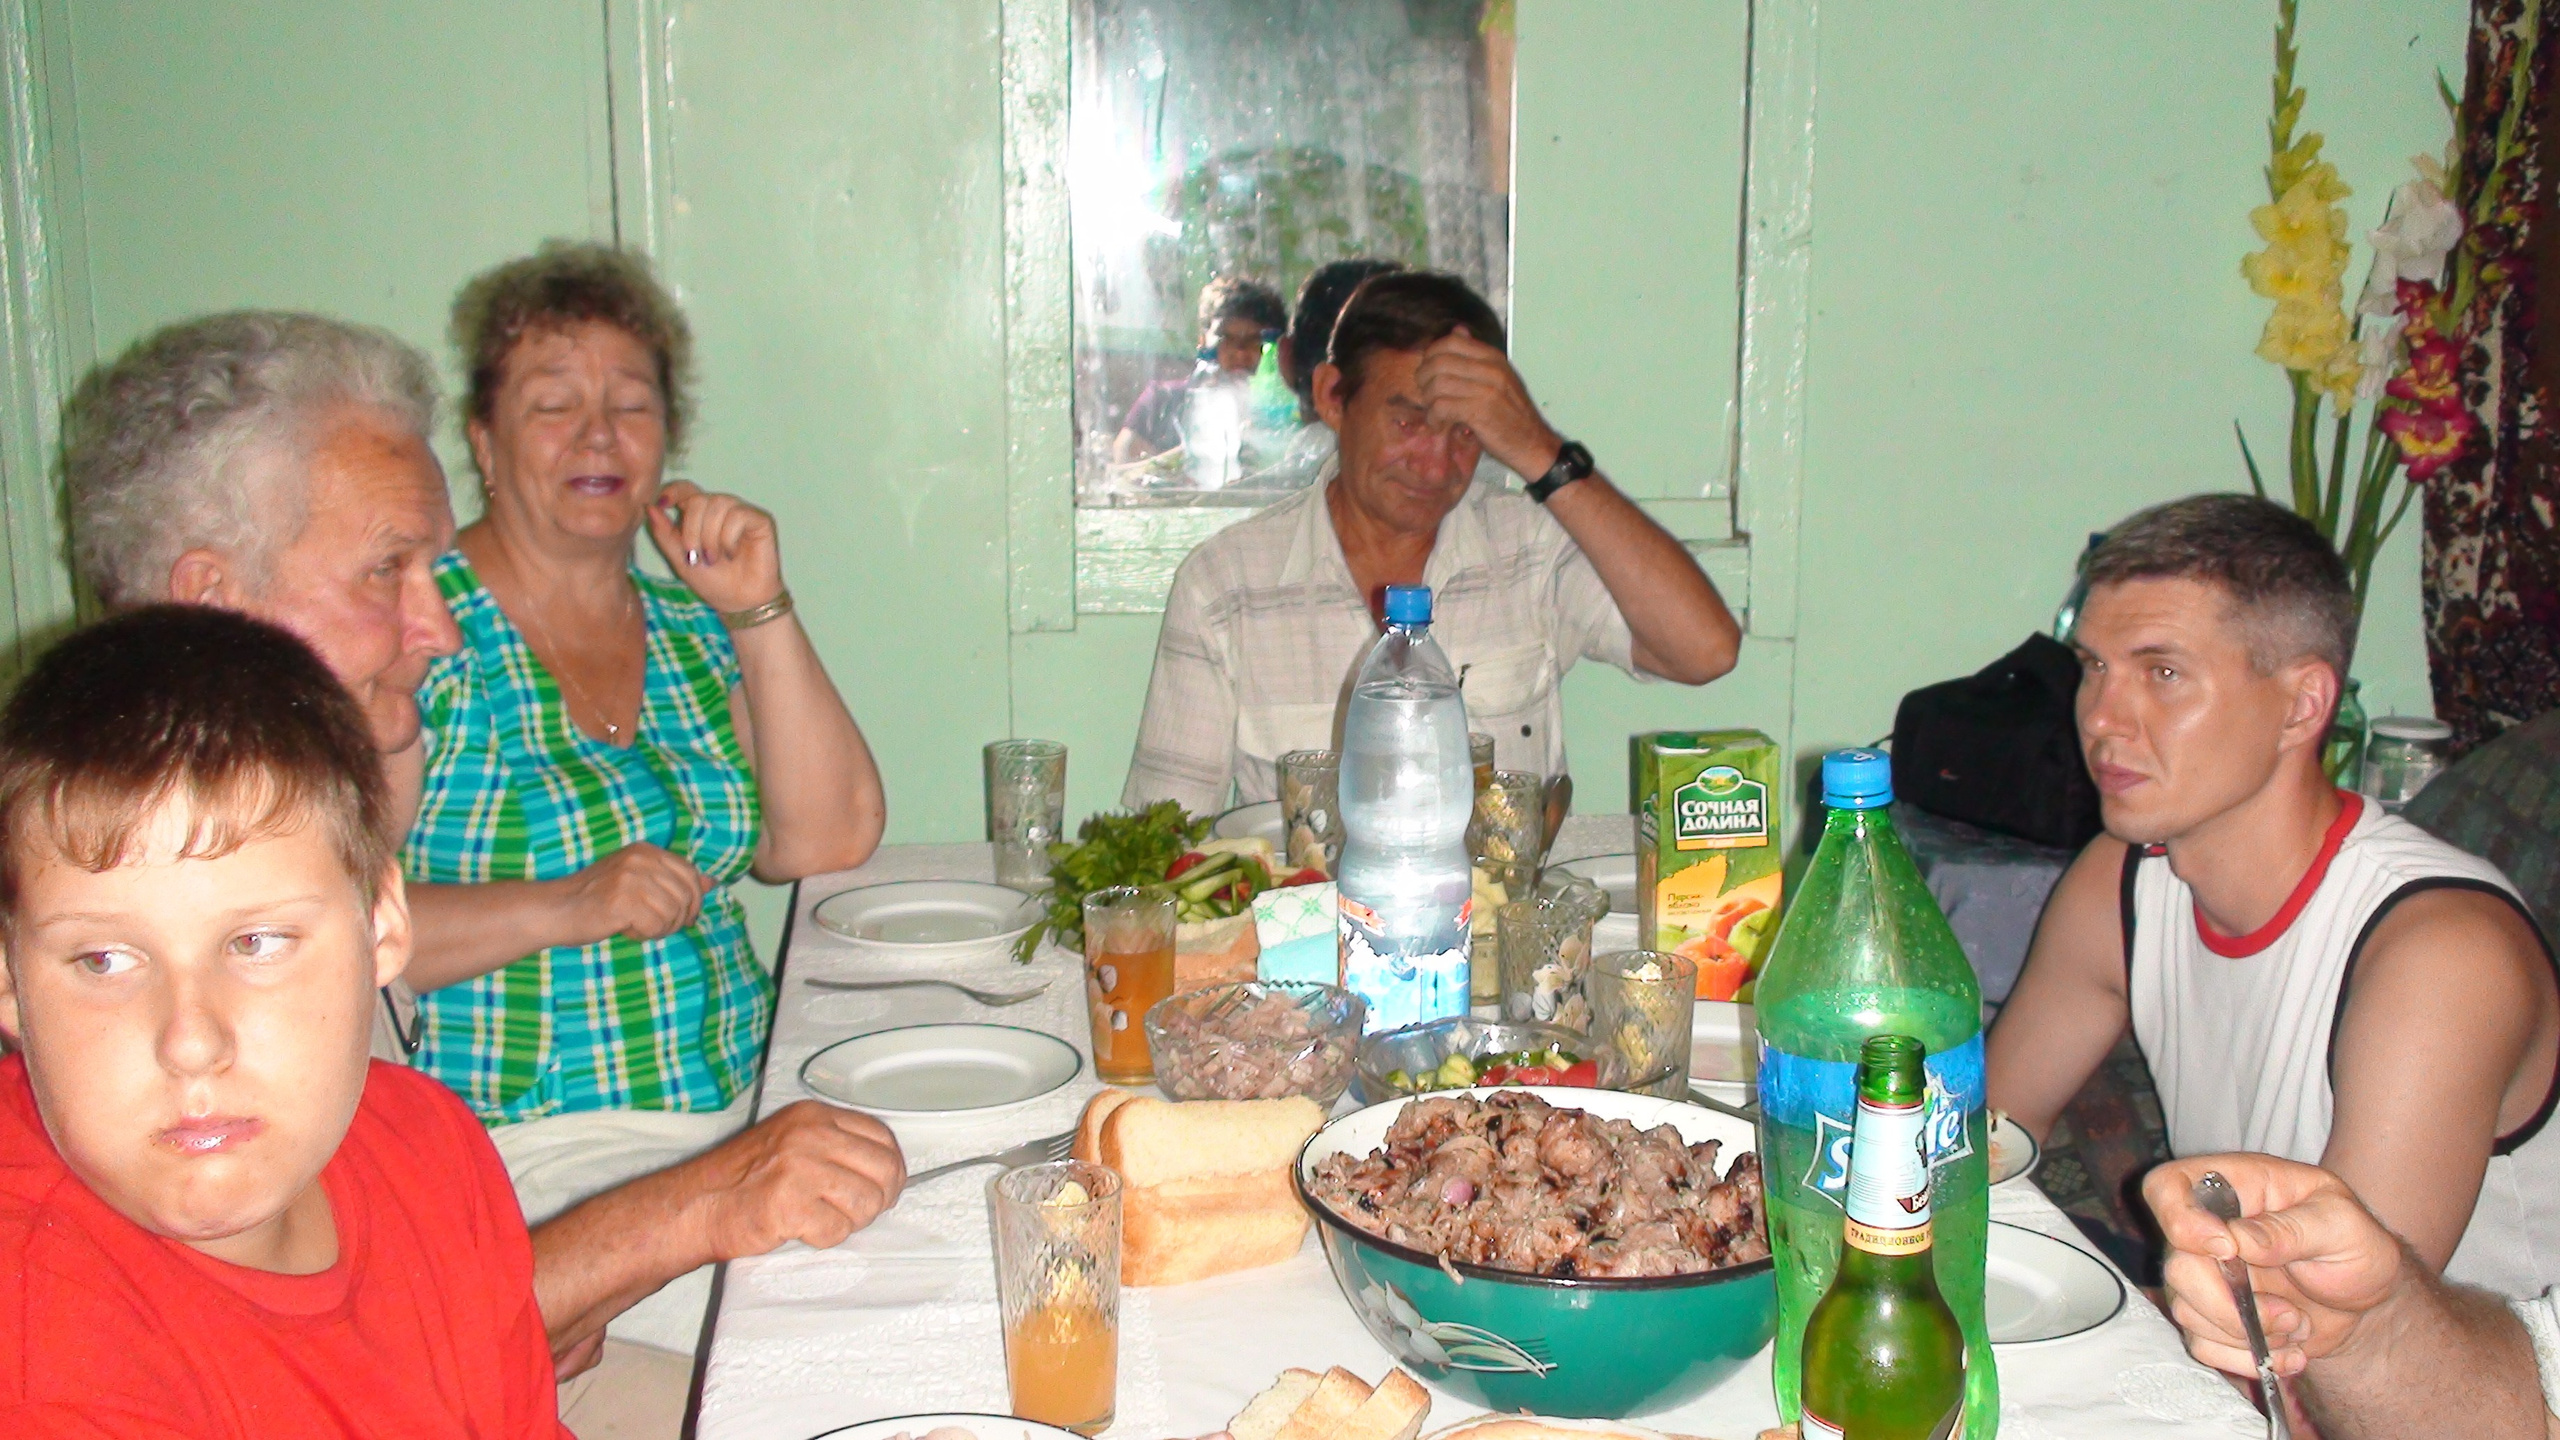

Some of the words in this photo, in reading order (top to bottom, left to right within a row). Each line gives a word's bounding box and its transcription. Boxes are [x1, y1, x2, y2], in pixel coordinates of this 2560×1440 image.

[1681, 799, 1760, 817] СОЧНАЯ
[1681, 813, 1762, 832] ДОЛИНА
[1817, 1096, 1962, 1191] Ste
